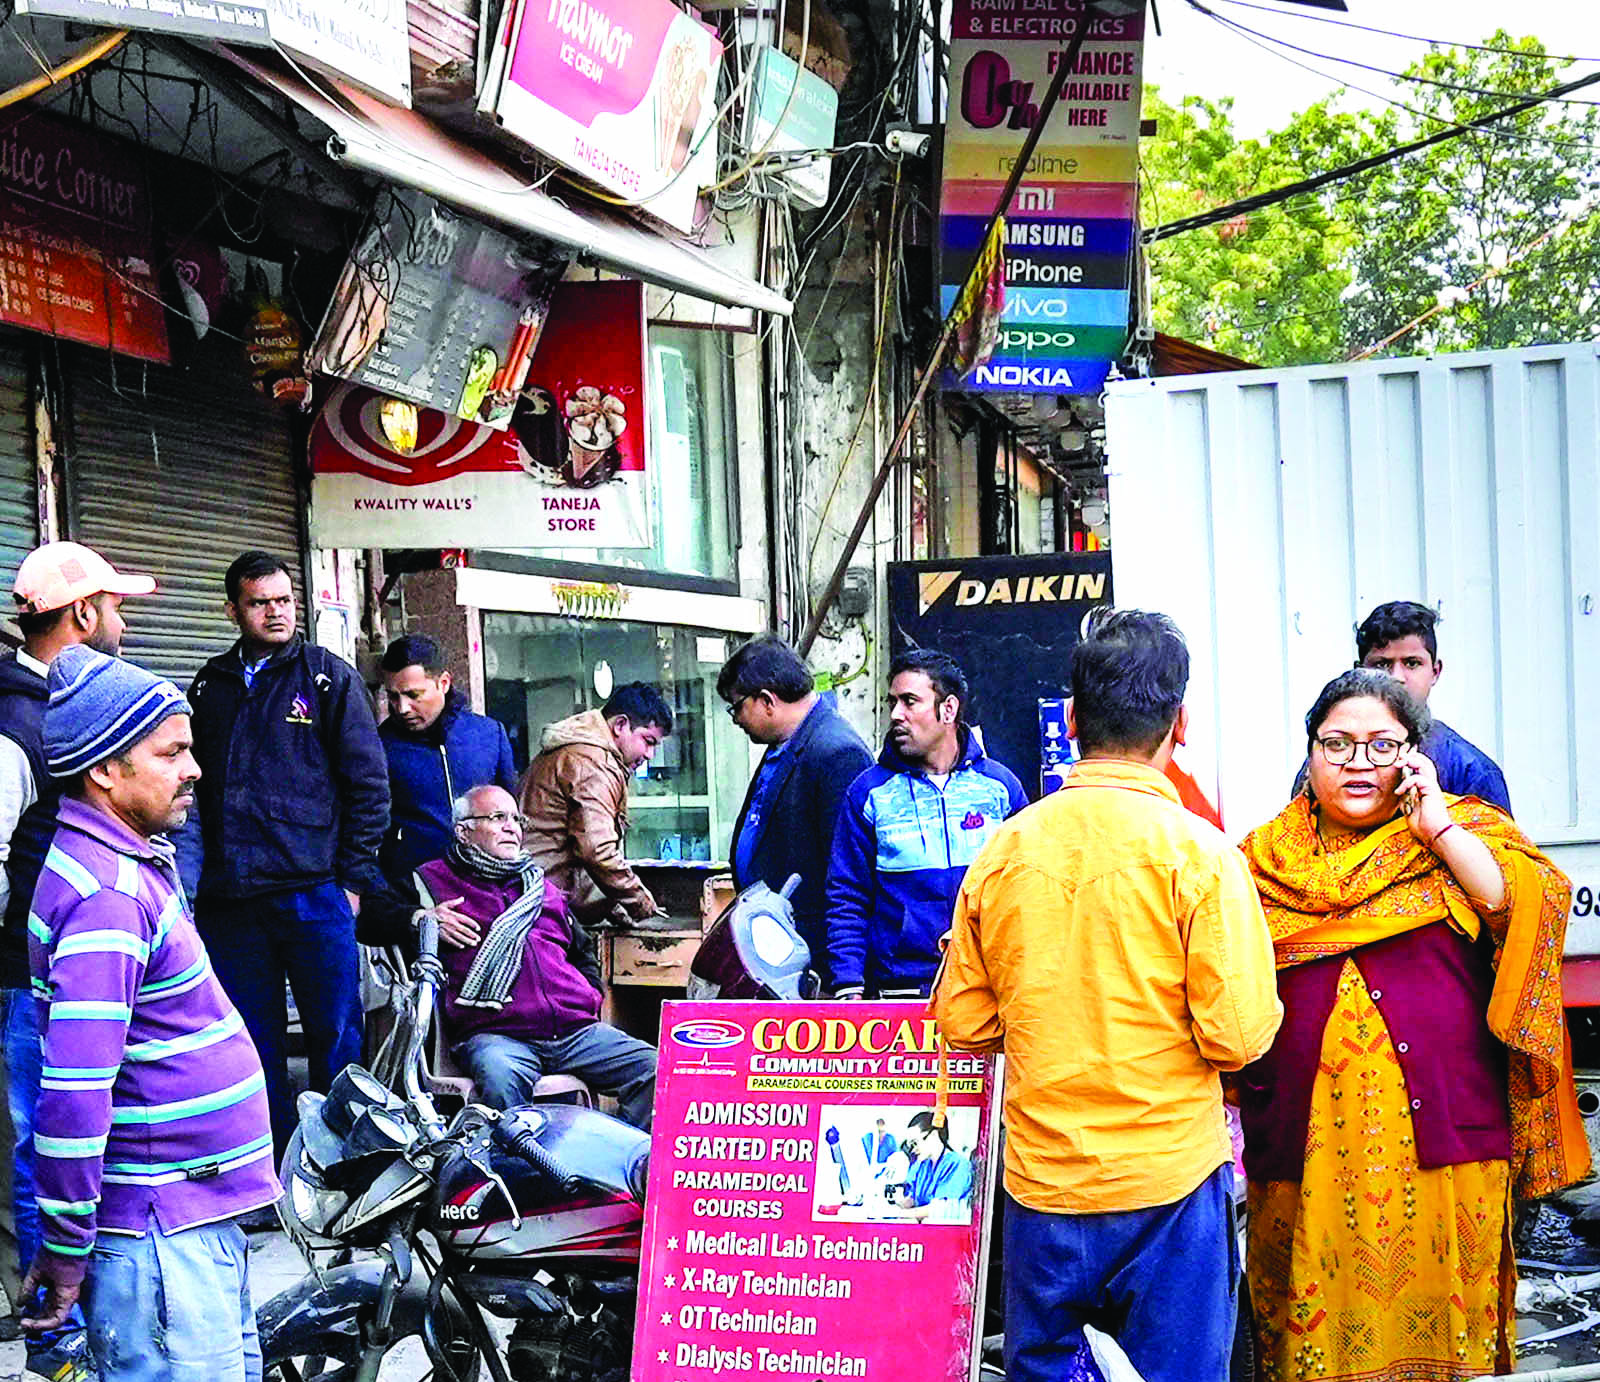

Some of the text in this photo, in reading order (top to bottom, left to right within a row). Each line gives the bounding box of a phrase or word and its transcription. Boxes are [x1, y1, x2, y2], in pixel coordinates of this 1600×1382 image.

[970, 17, 1125, 34] & ELECTROICS
[560, 42, 604, 84] ICE CREAM
[1059, 83, 1130, 101] VAILABLE
[1068, 108, 1108, 127] HERE
[574, 136, 641, 192] TANEJA STORE
[999, 153, 1078, 175] realme
[56, 148, 137, 217] Corner
[985, 223, 1085, 247] AMSUNG
[1006, 258, 1084, 283] iPhone
[1001, 292, 1069, 318] vivo
[975, 365, 1074, 388] NOKIA
[353, 498, 473, 511] KWALITY WALL'S
[541, 497, 601, 511] TANEJA
[547, 518, 597, 532] STORE
[955, 573, 1106, 607] DAIKIN
[752, 1018, 946, 1055] GODCA
[750, 1053, 883, 1075] COMMUNITY
[752, 1077, 979, 1091] PARAMEDICAL COURSES TRAINING INITUTE
[684, 1101, 809, 1127] ADMISSION
[673, 1135, 815, 1163] STARTED FOR
[673, 1170, 810, 1193] PARAMEDICAL
[693, 1198, 784, 1220] COURSES
[685, 1229, 925, 1262] Medical Lab Technician
[681, 1267, 853, 1299] X-Ray Technician
[679, 1305, 818, 1336] OT Technician
[675, 1342, 868, 1377] Dialysis Technician
